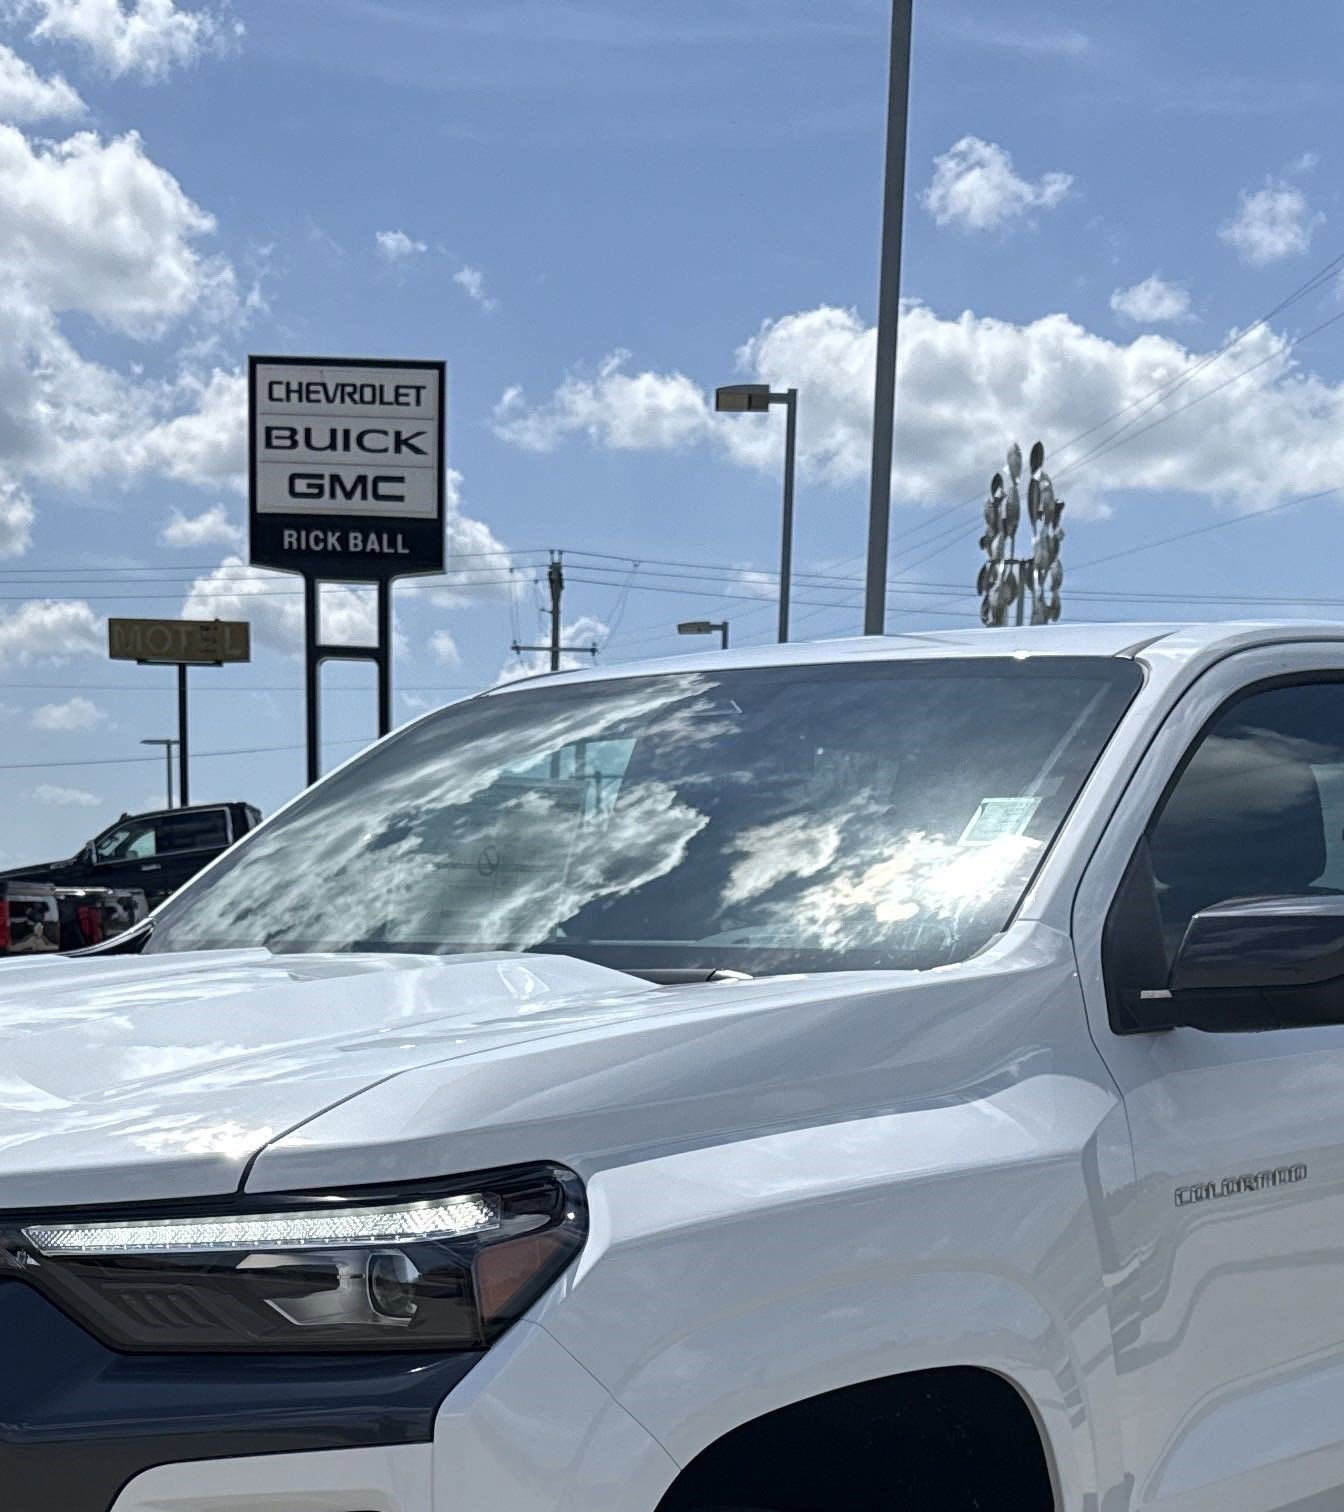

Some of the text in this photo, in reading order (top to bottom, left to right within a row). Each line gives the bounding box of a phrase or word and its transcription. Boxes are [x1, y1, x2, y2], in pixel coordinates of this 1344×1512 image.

[268, 381, 426, 407] CHEVROLET
[264, 426, 428, 455] BUICK
[288, 472, 406, 502] GMC
[283, 529, 410, 553] RICK BALL
[112, 624, 243, 655] MOTEL
